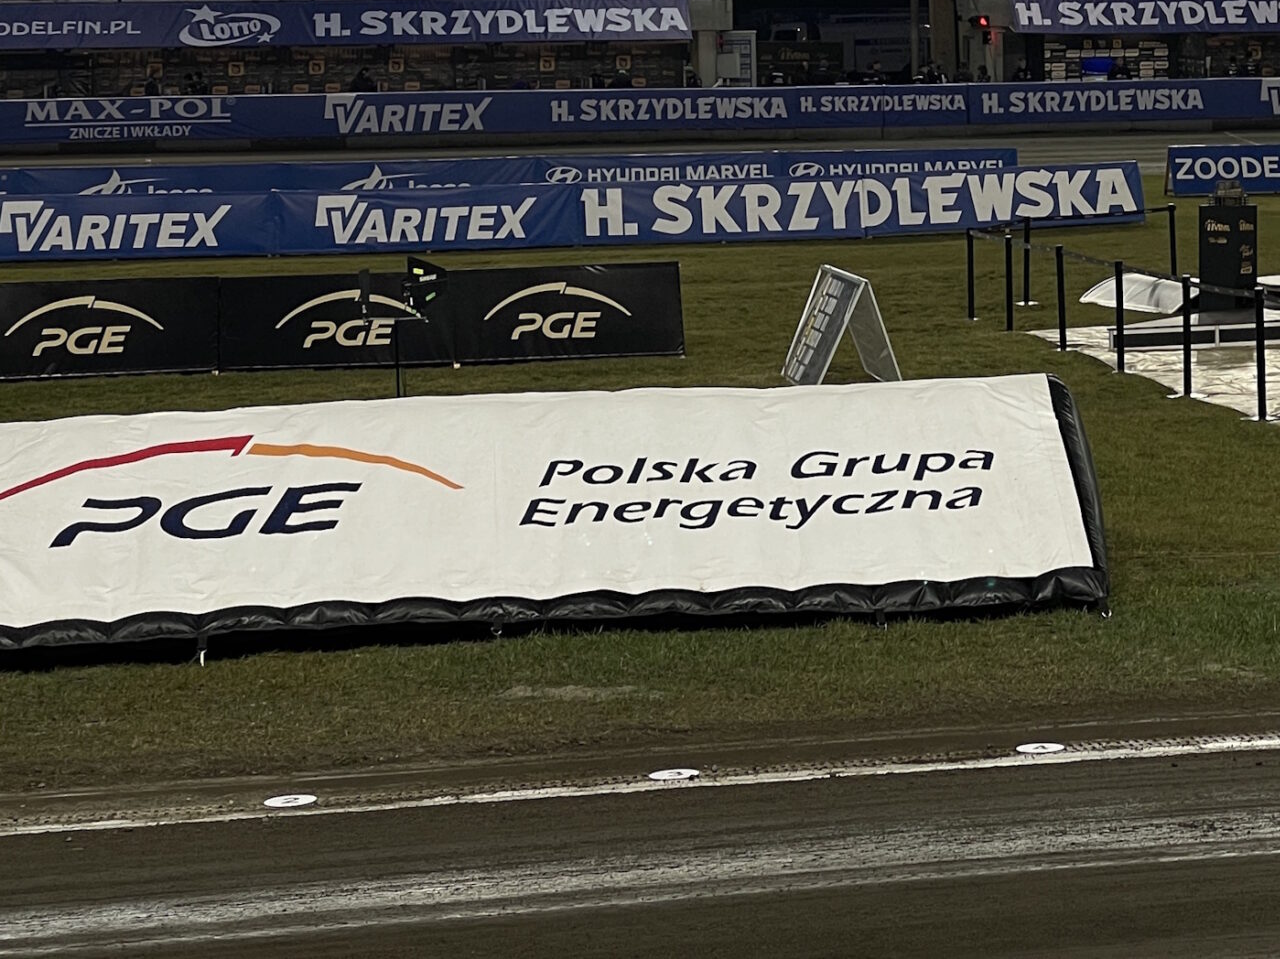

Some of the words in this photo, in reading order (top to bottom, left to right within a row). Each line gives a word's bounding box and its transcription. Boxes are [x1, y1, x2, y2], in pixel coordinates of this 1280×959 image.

[313, 12, 351, 37] H.
[360, 7, 688, 36] SKRZYDLEWSKA
[1015, 2, 1052, 26] H.
[200, 19, 262, 41] LOTTO
[25, 98, 233, 120] MAX-POL
[324, 93, 493, 134] VARITEX
[551, 100, 574, 122] H.
[579, 97, 789, 121] SKRZYDLEWSKA
[800, 96, 817, 113] H.
[820, 94, 966, 113] SKRZYDLEWSKA
[982, 93, 1004, 114] H.
[1009, 88, 1204, 113] SKRZYDLEWSKA
[69, 125, 121, 140] ZNICZE
[131, 123, 192, 138] WKŁADY
[588, 167, 680, 183] HYUNDAI
[686, 163, 775, 181] MARVEL
[581, 188, 638, 236] H.
[651, 168, 1138, 235] SKRZYDLEWSKA
[0, 200, 231, 252] VARITEX
[315, 195, 537, 244] VARITEX
[32, 325, 131, 357] PGE
[303, 318, 395, 349] PGE
[510, 311, 601, 341] PGE
[540, 456, 757, 488] Polska
[790, 450, 995, 481] Grupa
[50, 483, 362, 548] PGE
[519, 486, 983, 530] Energetyczna
